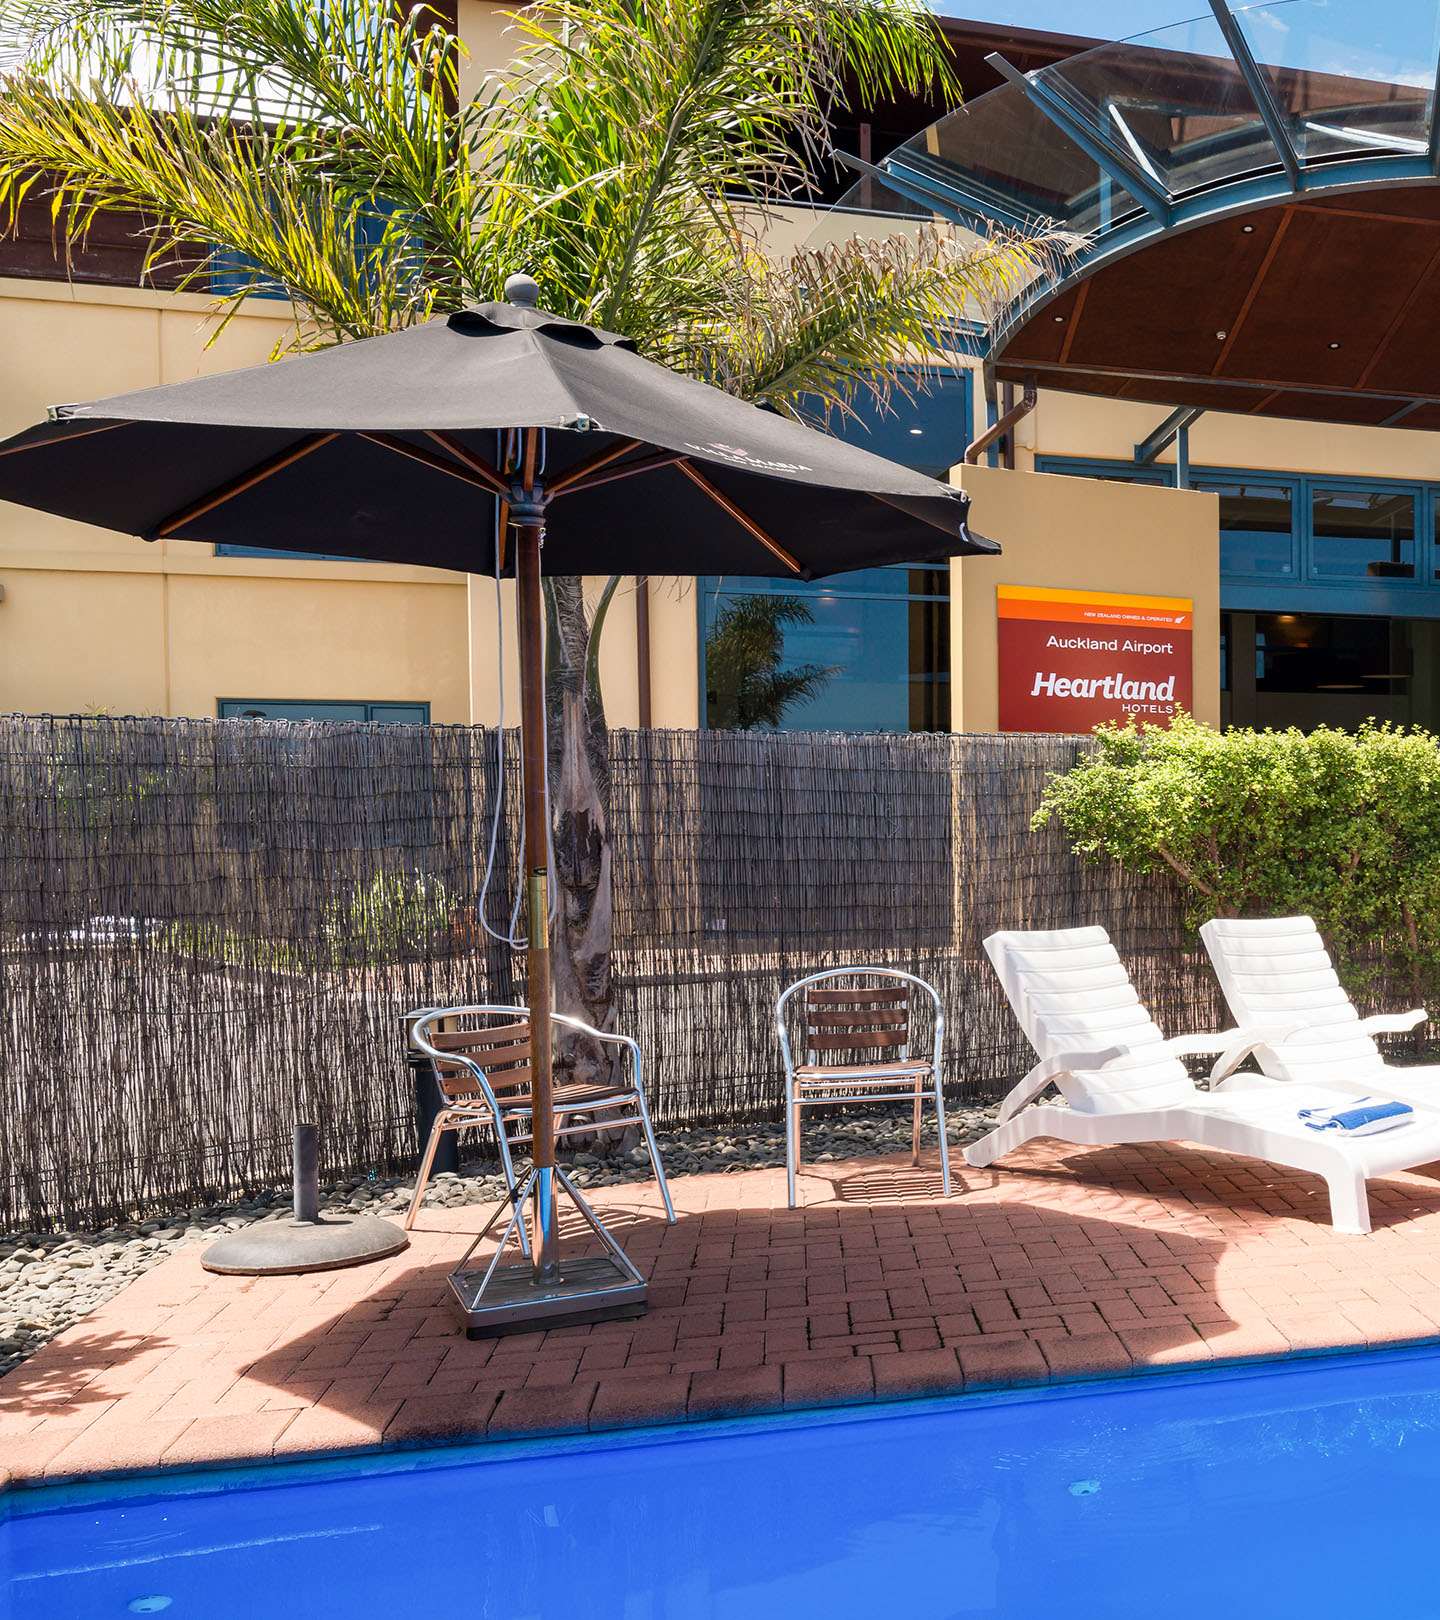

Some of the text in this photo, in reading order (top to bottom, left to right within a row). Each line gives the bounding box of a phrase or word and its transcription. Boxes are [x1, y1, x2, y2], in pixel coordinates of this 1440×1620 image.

[1046, 635, 1173, 655] Auckland Airport
[1030, 671, 1176, 702] Heartland
[1122, 703, 1174, 714] HOTELS
